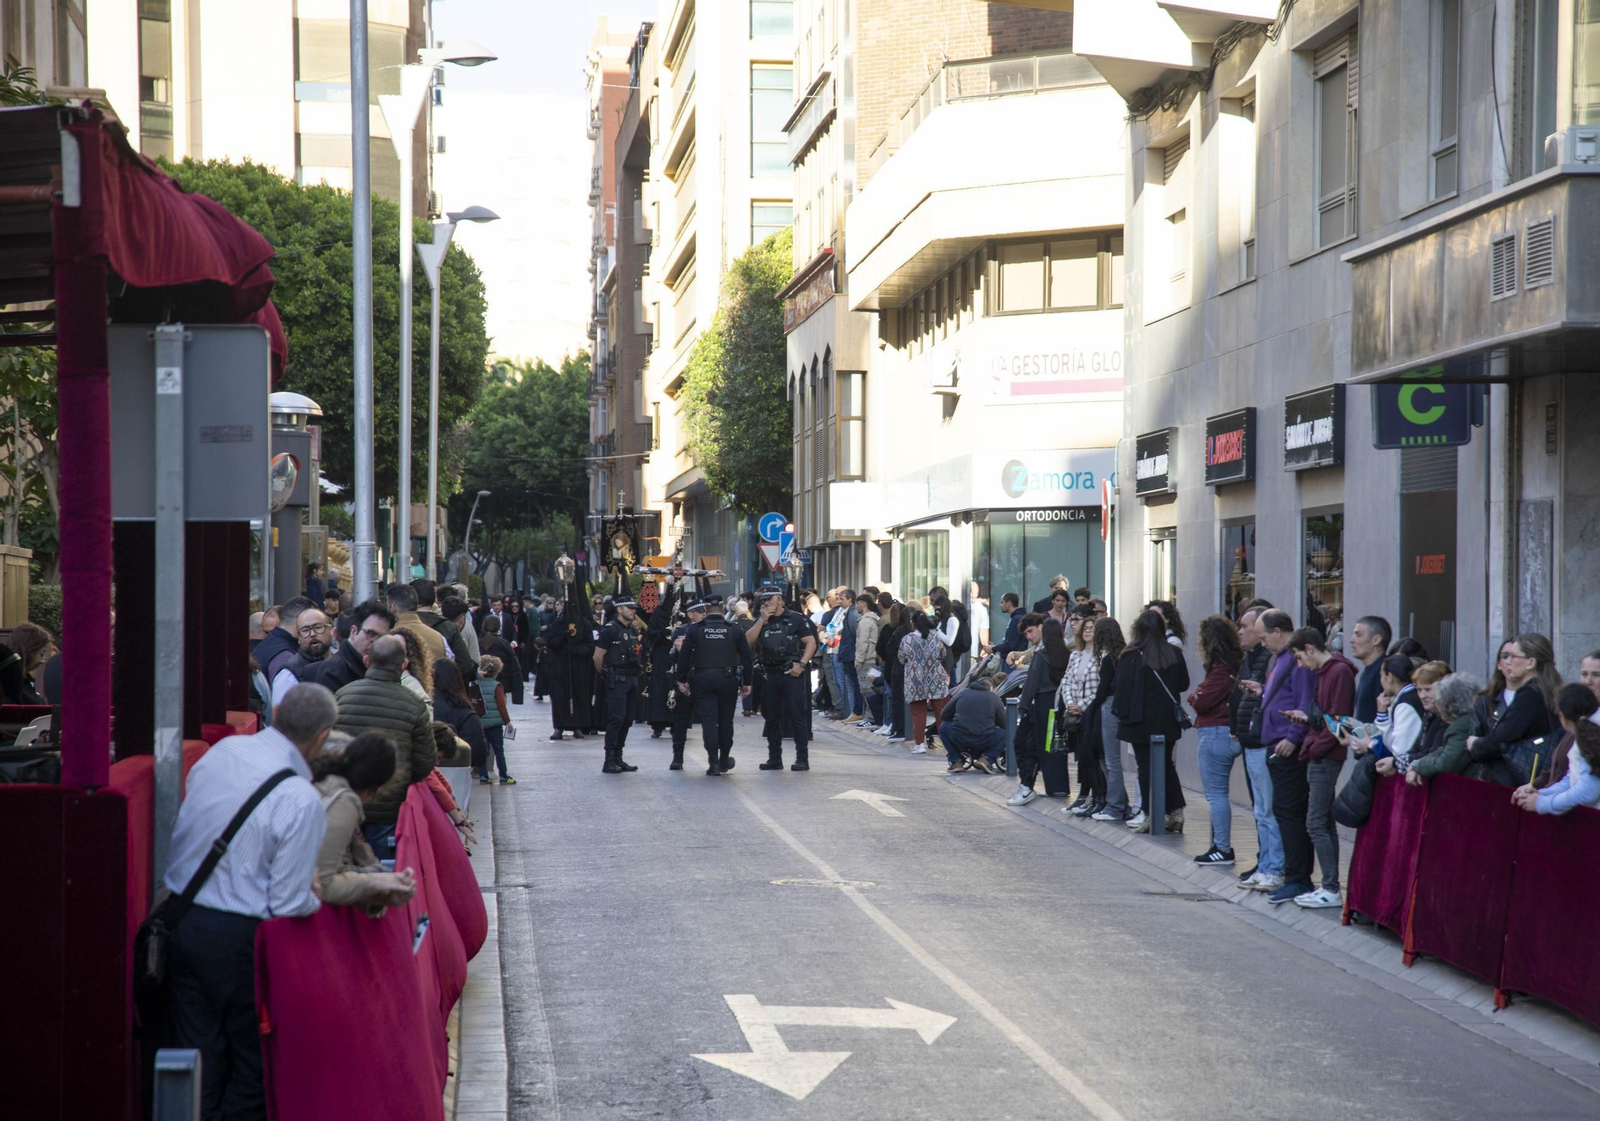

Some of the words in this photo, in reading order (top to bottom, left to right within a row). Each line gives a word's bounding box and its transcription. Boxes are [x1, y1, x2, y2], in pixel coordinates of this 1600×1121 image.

[1012, 347, 1086, 376] GESTORÍA
[1009, 465, 1095, 493] Zamora
[1015, 509, 1086, 521] ORTODONCIA
